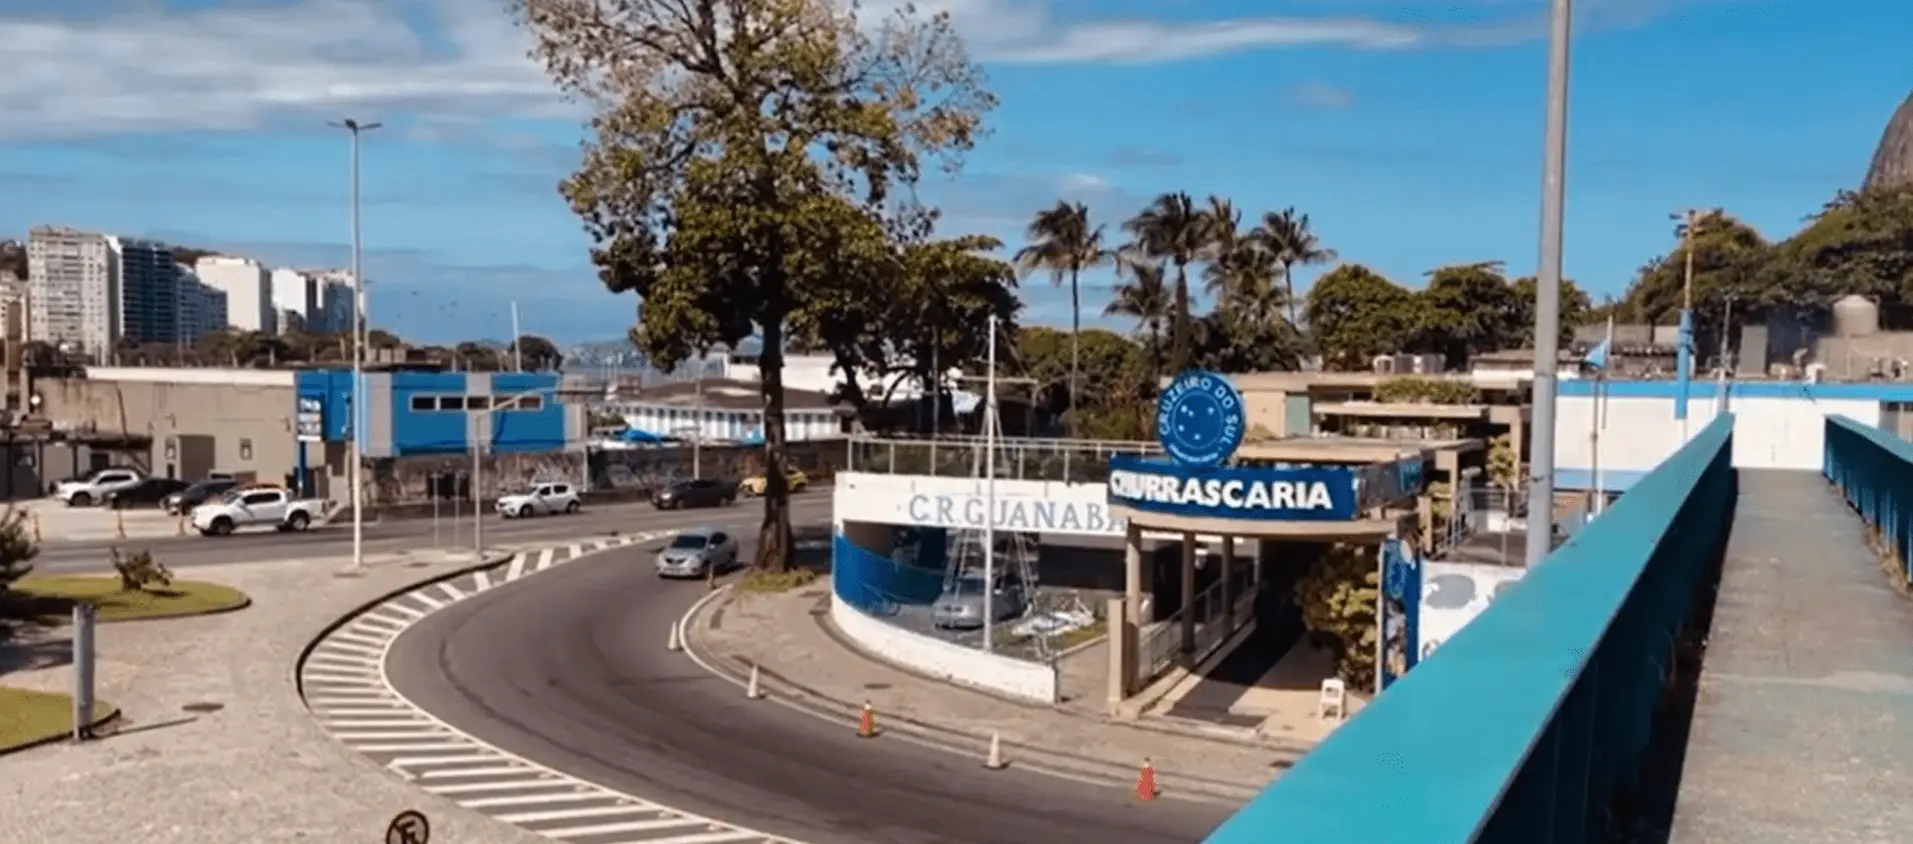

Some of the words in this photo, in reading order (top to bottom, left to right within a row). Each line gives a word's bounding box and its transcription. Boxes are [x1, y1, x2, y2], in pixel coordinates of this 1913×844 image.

[1159, 376, 1212, 436] CRUZEIRO
[1214, 384, 1235, 409] DO
[1220, 413, 1239, 445] SUL
